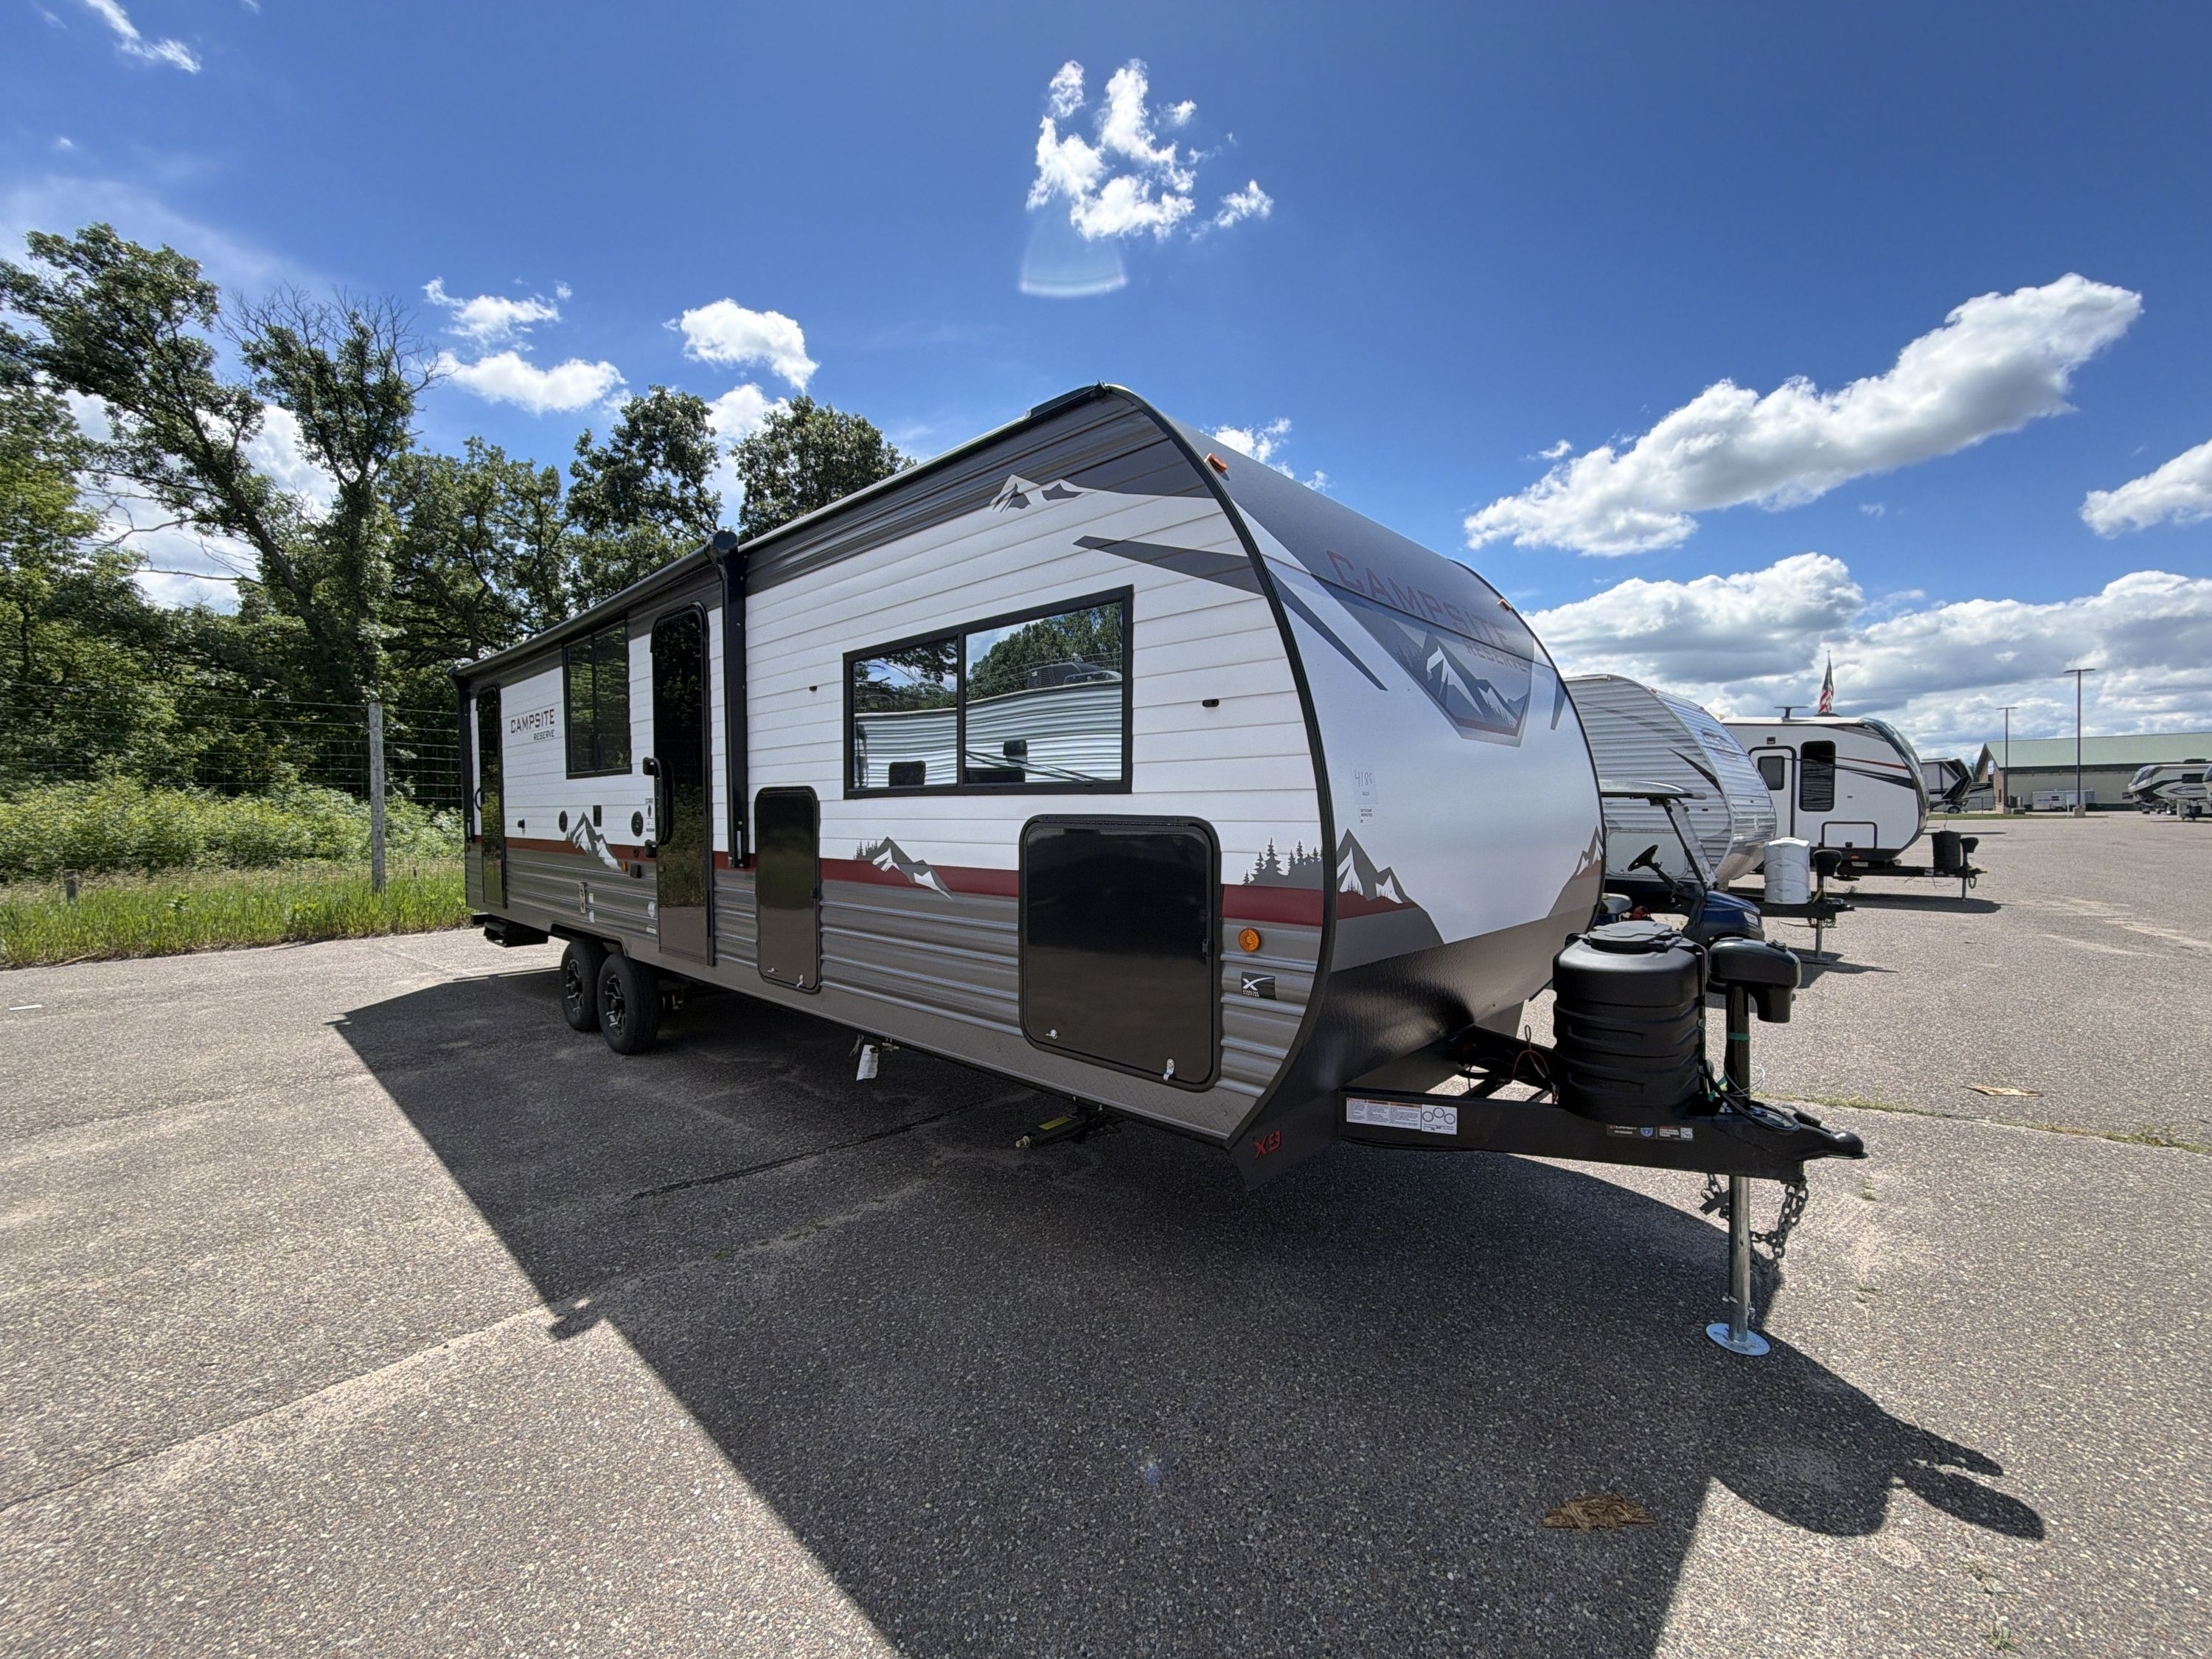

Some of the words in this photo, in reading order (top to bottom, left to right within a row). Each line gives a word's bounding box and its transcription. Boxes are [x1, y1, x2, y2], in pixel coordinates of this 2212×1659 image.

[1326, 549, 1517, 653] CAMPSITE
[510, 709, 555, 734] CAMPSITE
[533, 728, 555, 741] RESERVE
